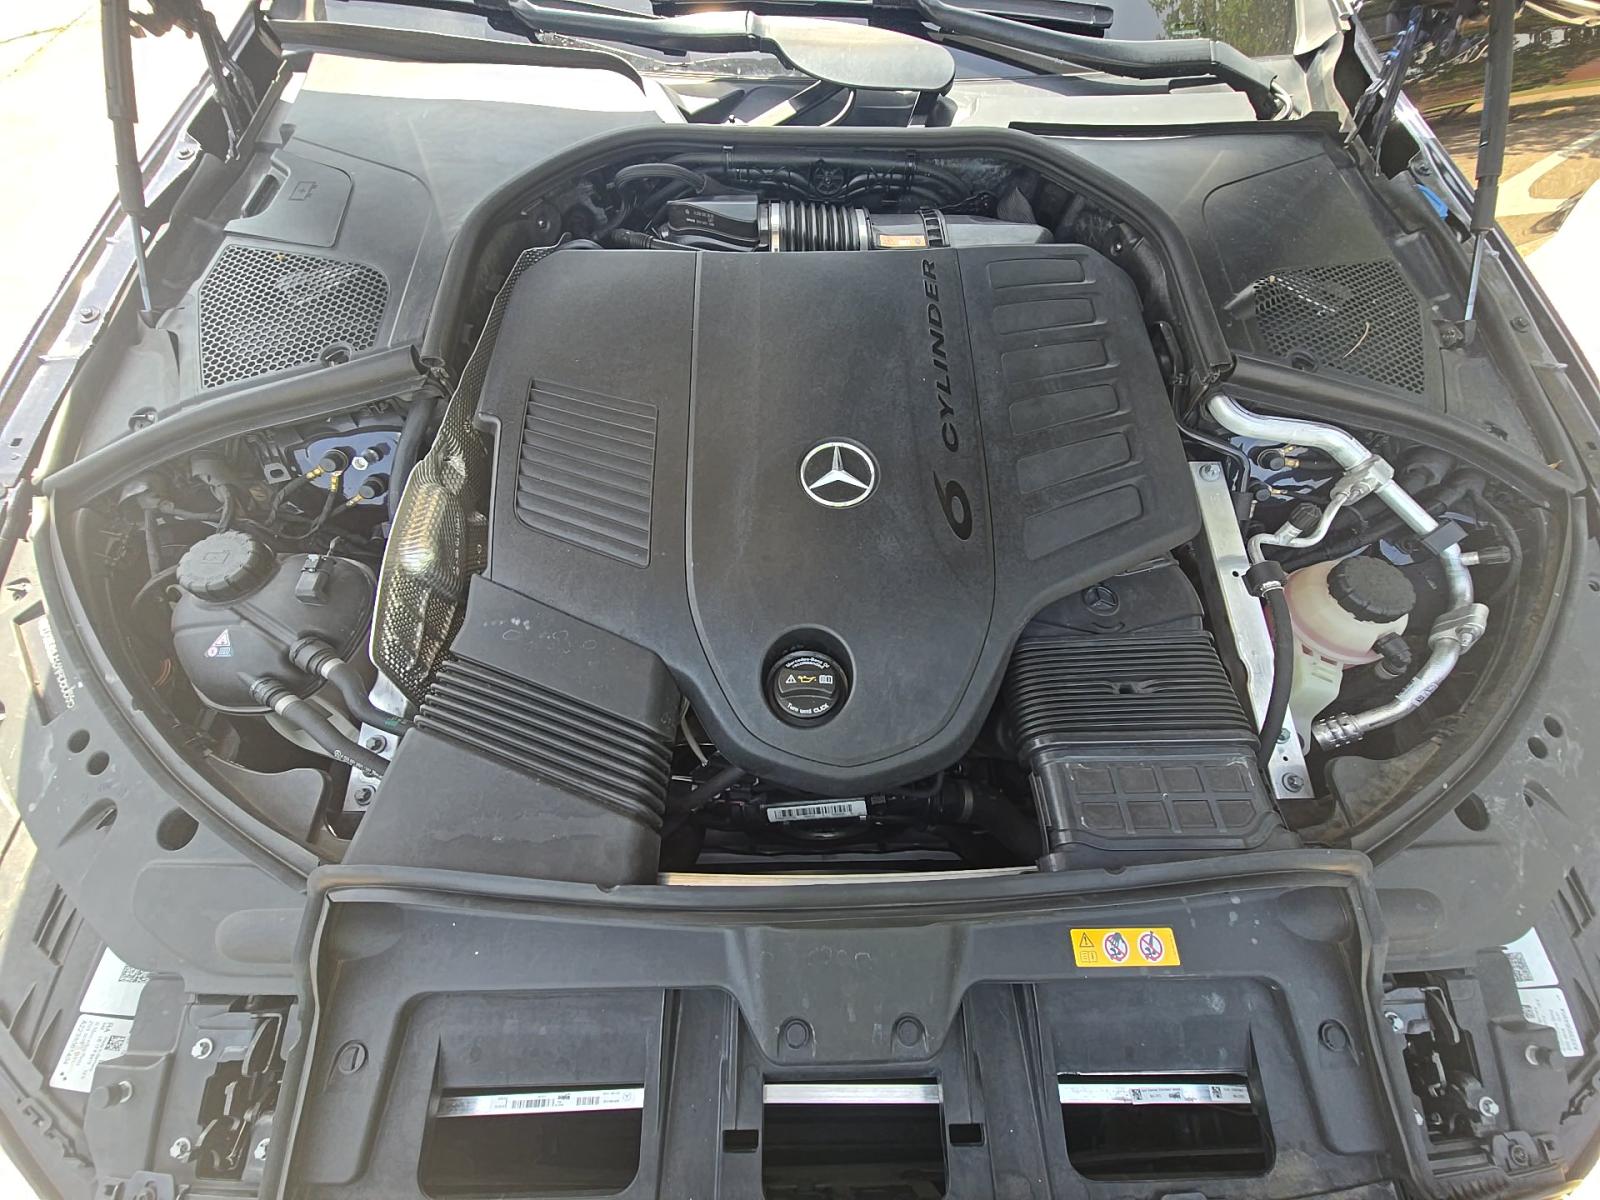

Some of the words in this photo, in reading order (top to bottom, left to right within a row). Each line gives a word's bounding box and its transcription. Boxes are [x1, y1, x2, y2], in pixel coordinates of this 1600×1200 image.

[921, 258, 959, 453] CYLINDER
[932, 470, 973, 541] 6
[813, 702, 830, 713] CLICK
